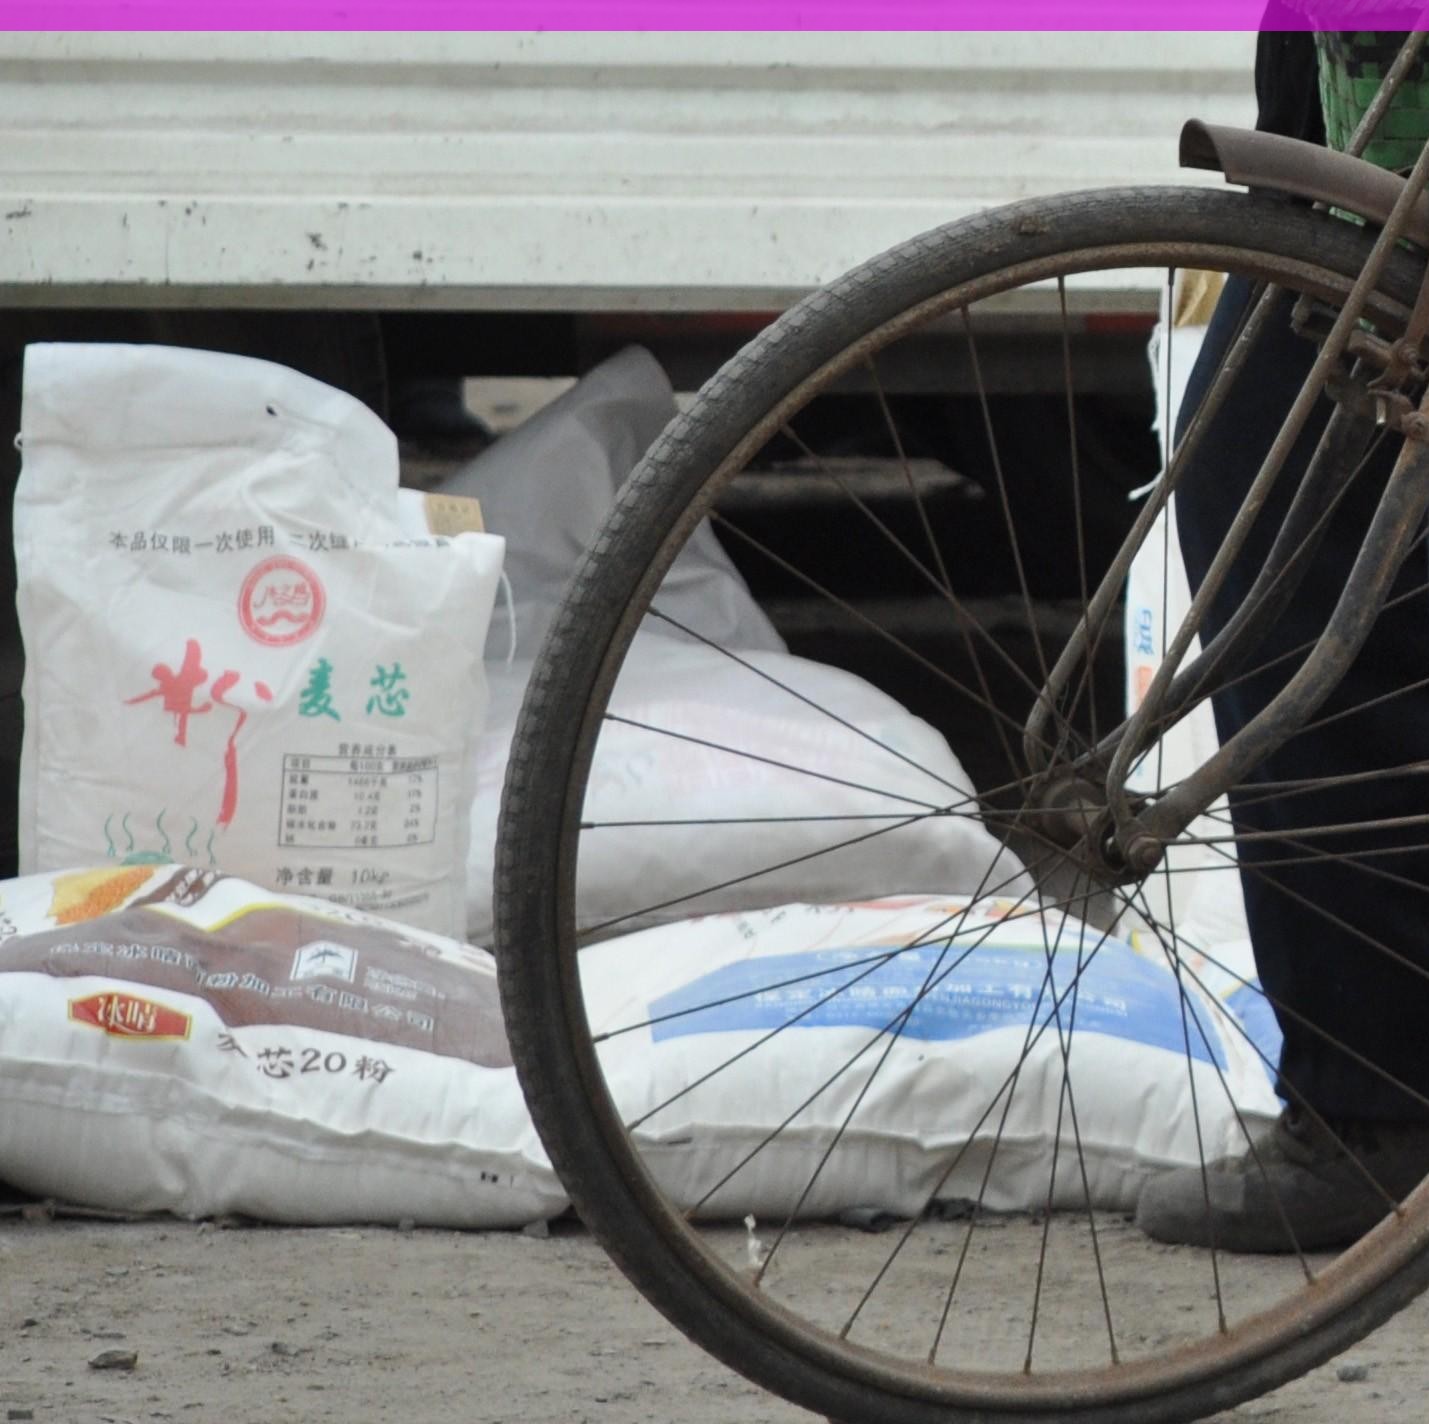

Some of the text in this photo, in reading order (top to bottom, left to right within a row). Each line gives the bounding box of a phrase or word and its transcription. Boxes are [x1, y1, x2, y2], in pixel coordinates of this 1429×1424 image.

[109, 526, 275, 555] 本品仅限一次使用
[298, 658, 412, 721] 麦芯
